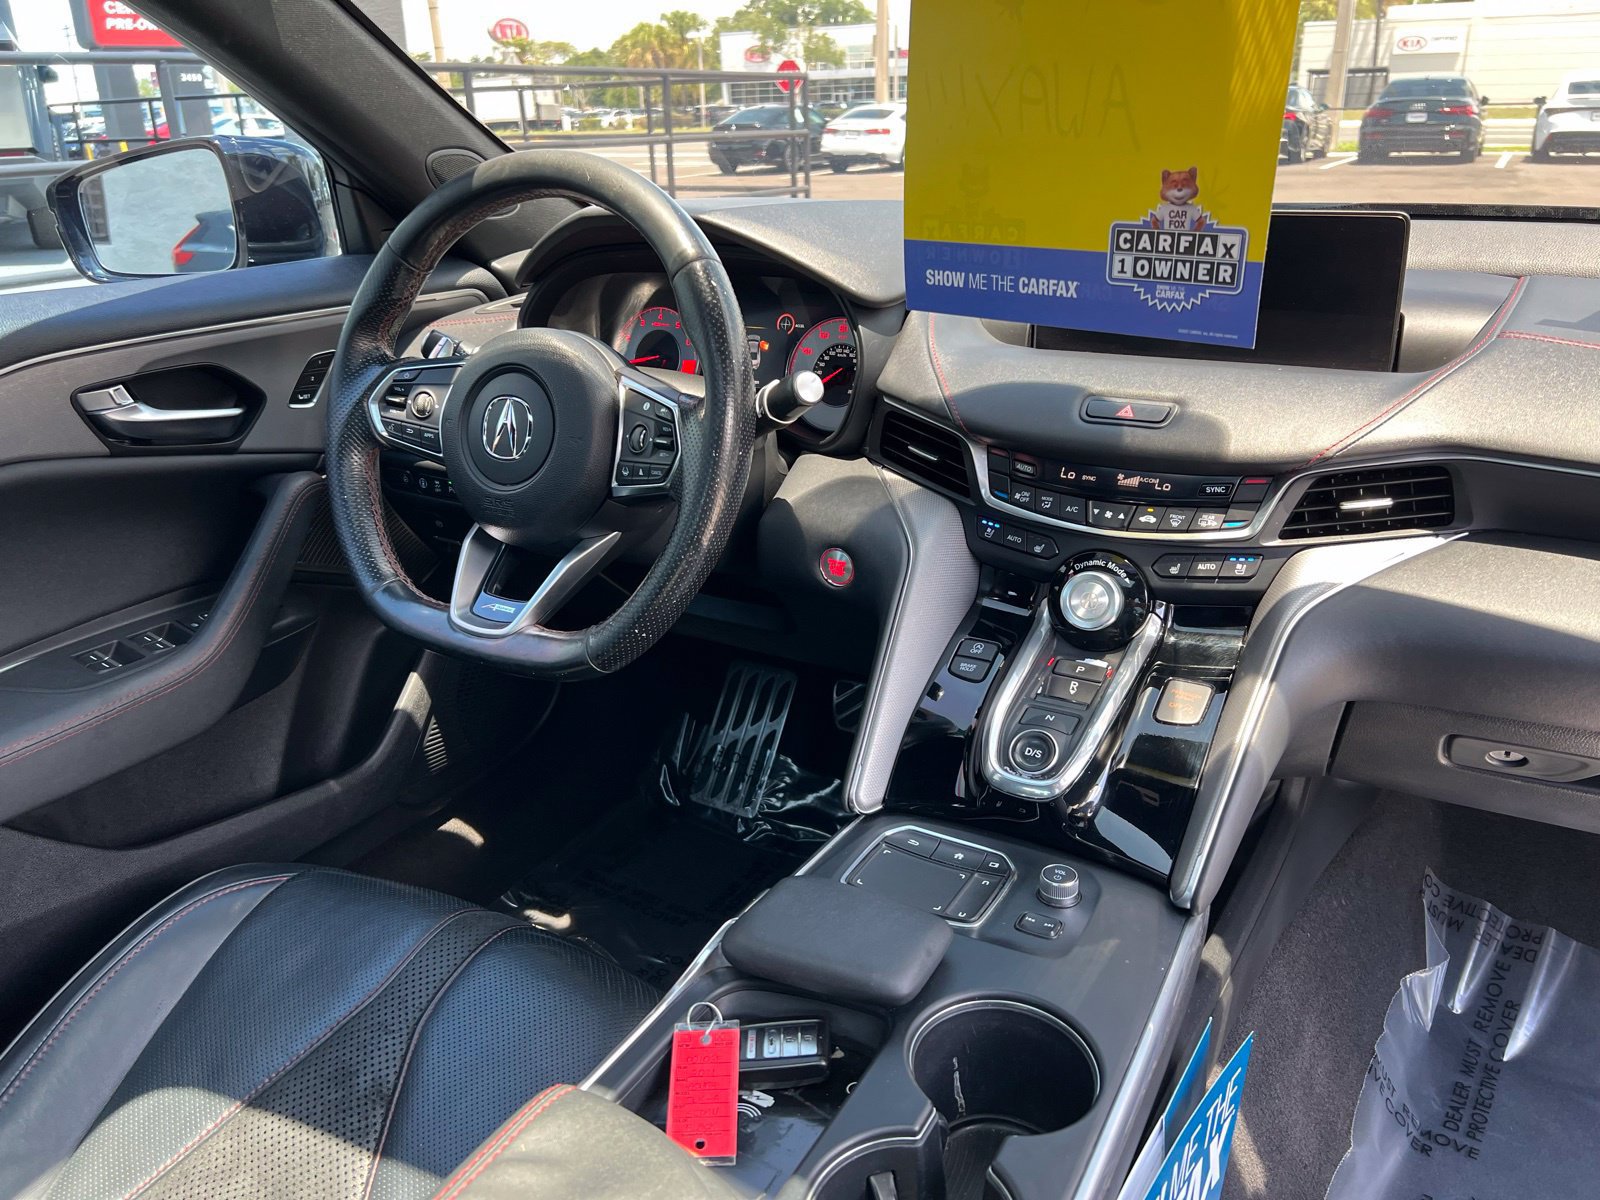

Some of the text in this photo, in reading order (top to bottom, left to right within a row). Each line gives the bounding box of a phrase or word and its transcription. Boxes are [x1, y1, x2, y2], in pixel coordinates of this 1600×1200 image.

[1168, 210, 1188, 219] CAR
[1168, 219, 1186, 229] FOX
[1118, 231, 1236, 259] CARFAX
[925, 269, 1080, 298] SHOW ME THE CARFAX
[1155, 290, 1185, 300] CARFAX
[675, 321, 681, 329] 5
[1016, 463, 1032, 472] AUTO
[1065, 505, 1079, 513] A/C
[1006, 534, 1022, 544] AUTO
[1073, 558, 1127, 578] Dynamic Mode
[1075, 665, 1085, 673] P
[1024, 747, 1042, 758] D/S
[1054, 868, 1066, 876] VOL
[1427, 899, 1464, 933] MUST
[1442, 960, 1511, 1132] DEALER MUST REMOVE
[1466, 999, 1521, 1143] PROTECTIVE COVER
[1203, 1066, 1242, 1150] THE
[1385, 1097, 1433, 1157] COVER
